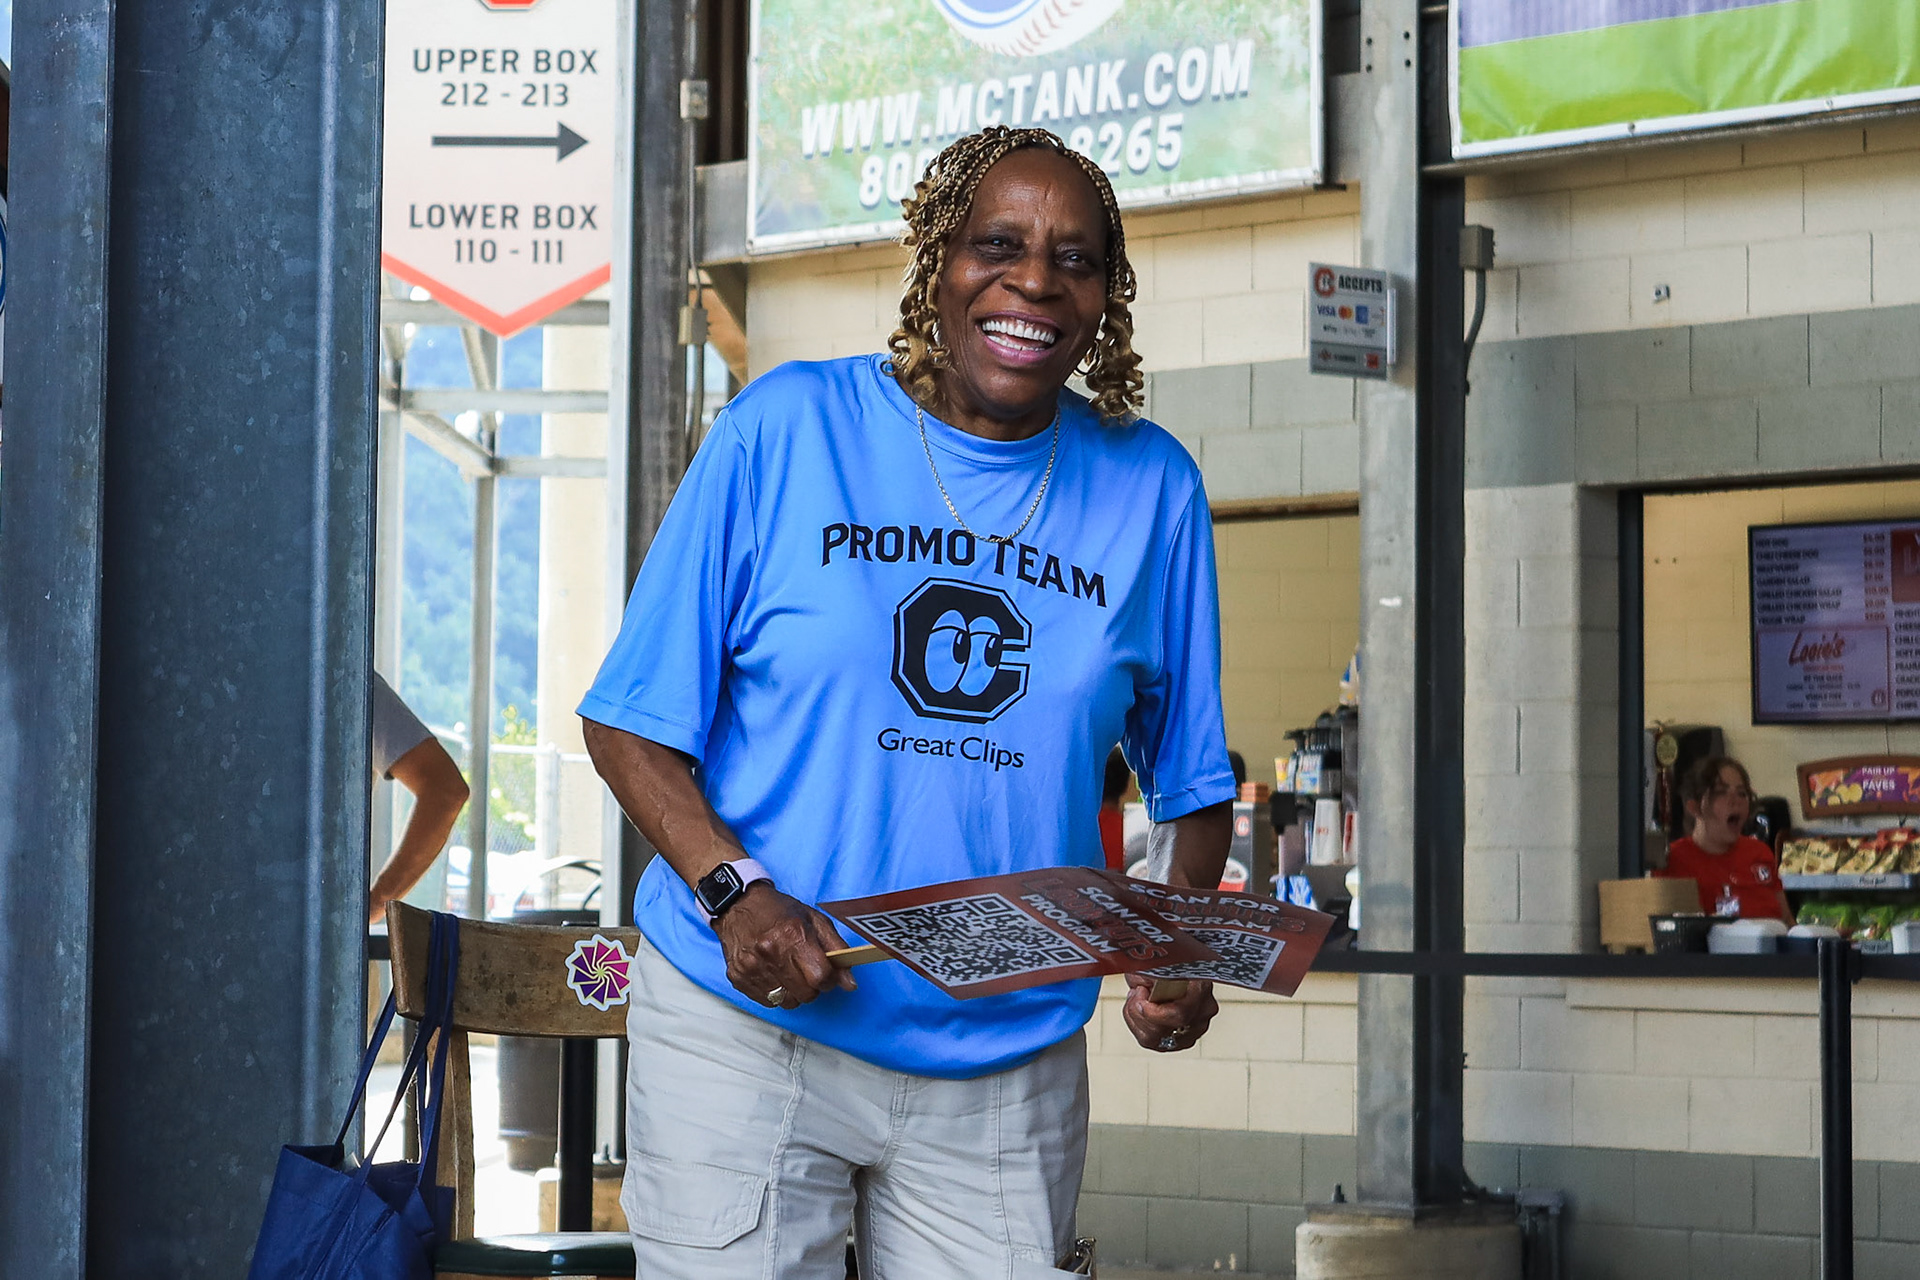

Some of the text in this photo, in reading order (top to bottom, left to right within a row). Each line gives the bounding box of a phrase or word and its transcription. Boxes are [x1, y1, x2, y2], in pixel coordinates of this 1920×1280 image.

[412, 48, 598, 75] UPPER BOX
[440, 83, 489, 106] 212
[521, 83, 570, 106] 213
[801, 38, 1256, 159] WWW.MCTANK.COM
[409, 204, 598, 230] LOWER BOX
[454, 239, 497, 264] 110
[531, 239, 564, 264] 111
[1338, 275, 1383, 293] ACCEPTS
[1317, 305, 1336, 317] VISA
[821, 522, 1108, 609] PROMO TEAM
[877, 727, 1025, 772] Great Clips
[1862, 766, 1895, 775] PAIR UP
[1128, 883, 1280, 915] SCAN FOR
[1020, 893, 1121, 954] PROGRAM
[1077, 886, 1174, 944] SCAN FOR
[1153, 909, 1272, 933] OGRAM
